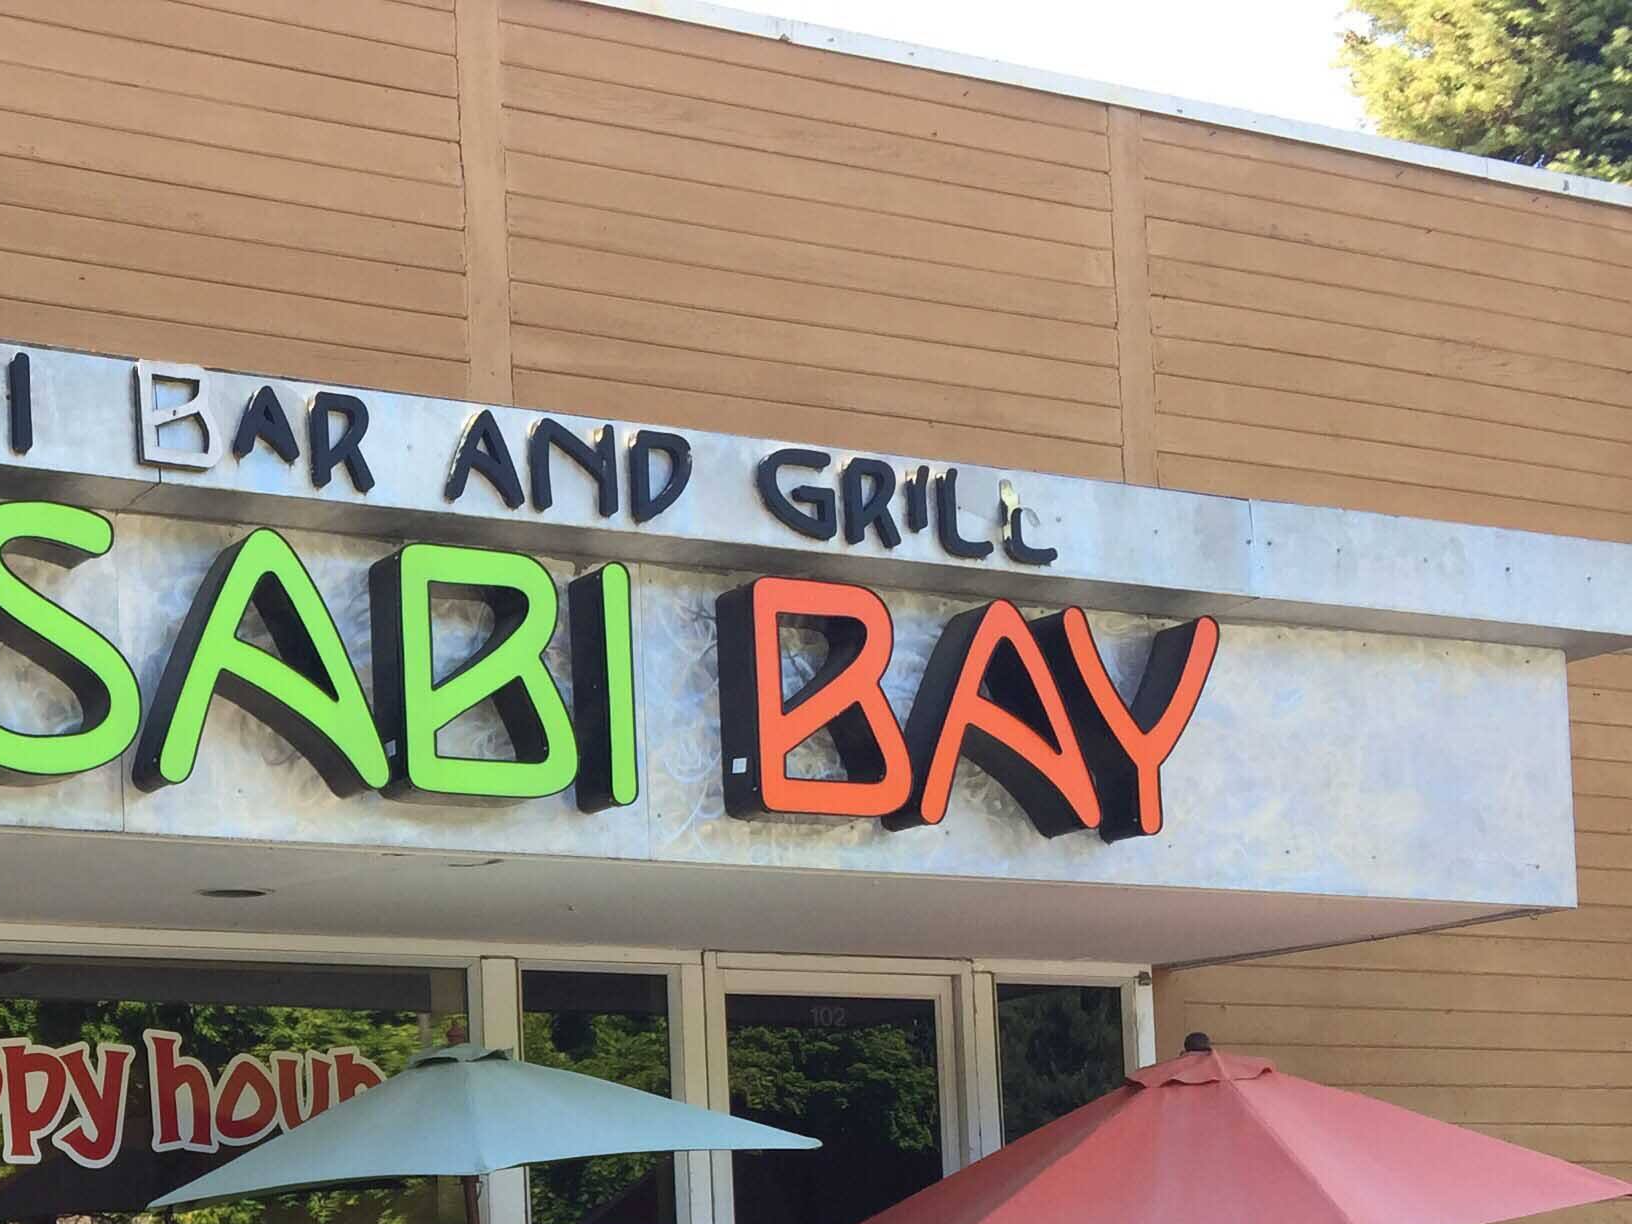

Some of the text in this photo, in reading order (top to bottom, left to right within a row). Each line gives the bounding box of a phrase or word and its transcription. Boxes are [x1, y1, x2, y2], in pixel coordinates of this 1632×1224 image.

[133, 359, 375, 494] BAR
[444, 409, 693, 524] AND
[757, 446, 1059, 566] GRILL
[717, 576, 1220, 843] BAY
[809, 1007, 846, 1027] 102
